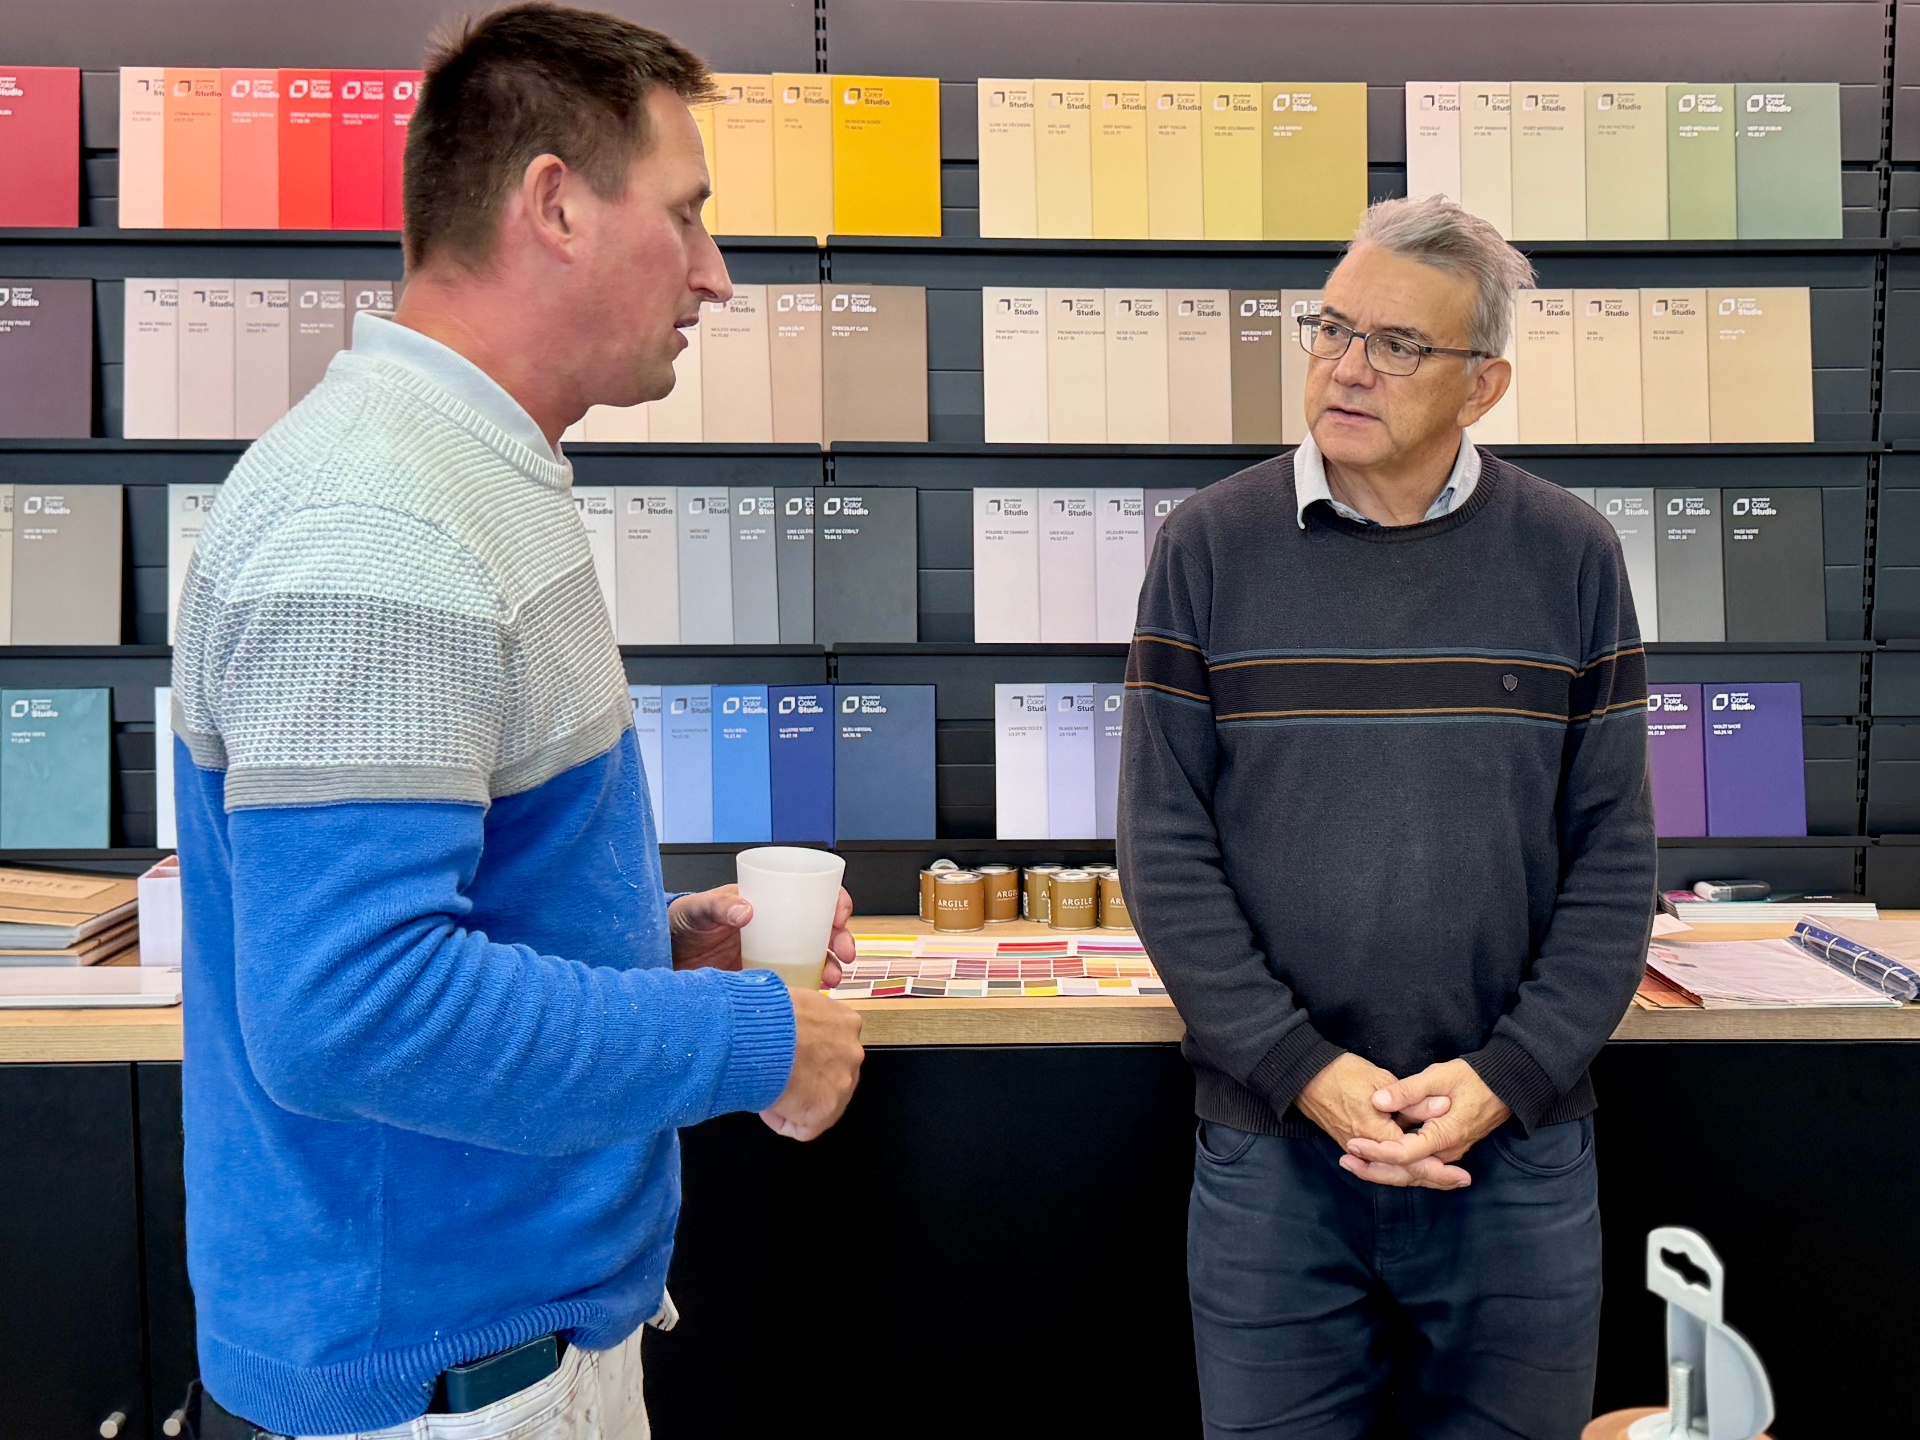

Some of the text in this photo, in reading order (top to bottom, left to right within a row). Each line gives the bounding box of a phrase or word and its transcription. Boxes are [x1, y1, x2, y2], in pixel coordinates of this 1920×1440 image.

[1292, 104, 1318, 112] Studio
[796, 304, 822, 312] Studio
[1738, 308, 1763, 316] Studio
[1625, 508, 1649, 516] Studio
[1686, 508, 1710, 516] Studio
[1752, 508, 1776, 516] Studio
[32, 710, 58, 718] Studio
[798, 706, 824, 714] Studio
[862, 706, 886, 714] Studio
[938, 900, 969, 908] ARGILE
[1062, 897, 1092, 906] ARGILE
